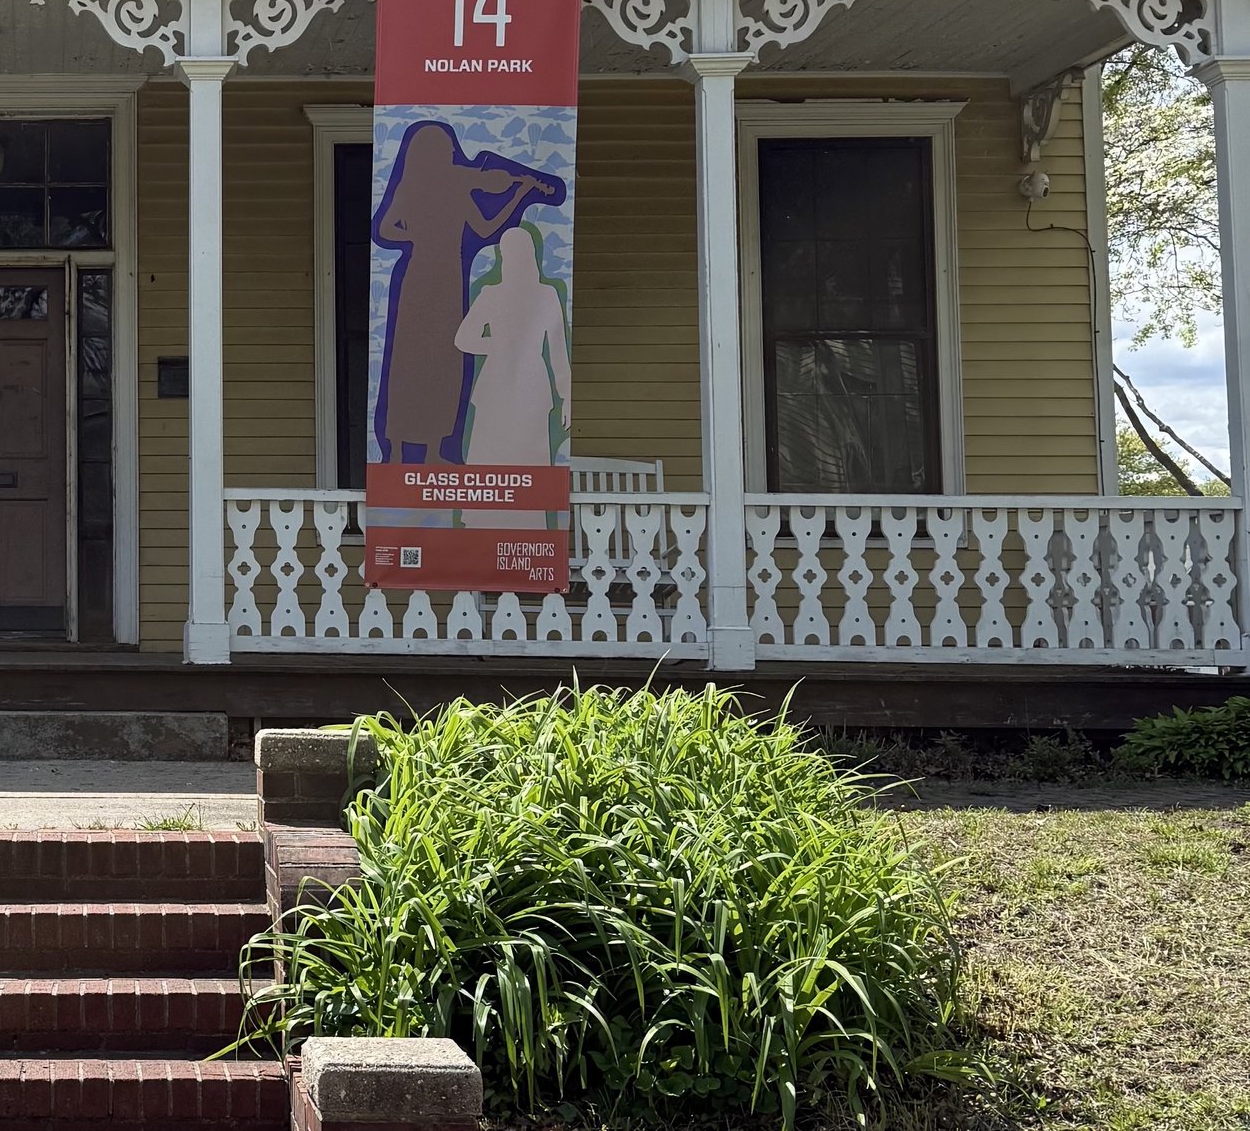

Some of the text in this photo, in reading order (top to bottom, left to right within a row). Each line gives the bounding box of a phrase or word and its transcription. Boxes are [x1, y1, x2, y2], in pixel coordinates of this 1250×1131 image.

[424, 59, 533, 73] NOLAN PARK
[404, 472, 533, 487] GLASS CLOUDS
[422, 488, 515, 502] ENSEMBLE
[497, 542, 555, 557] GOVERNORS
[496, 556, 531, 571] ISLAND
[528, 567, 554, 581] ARTS
